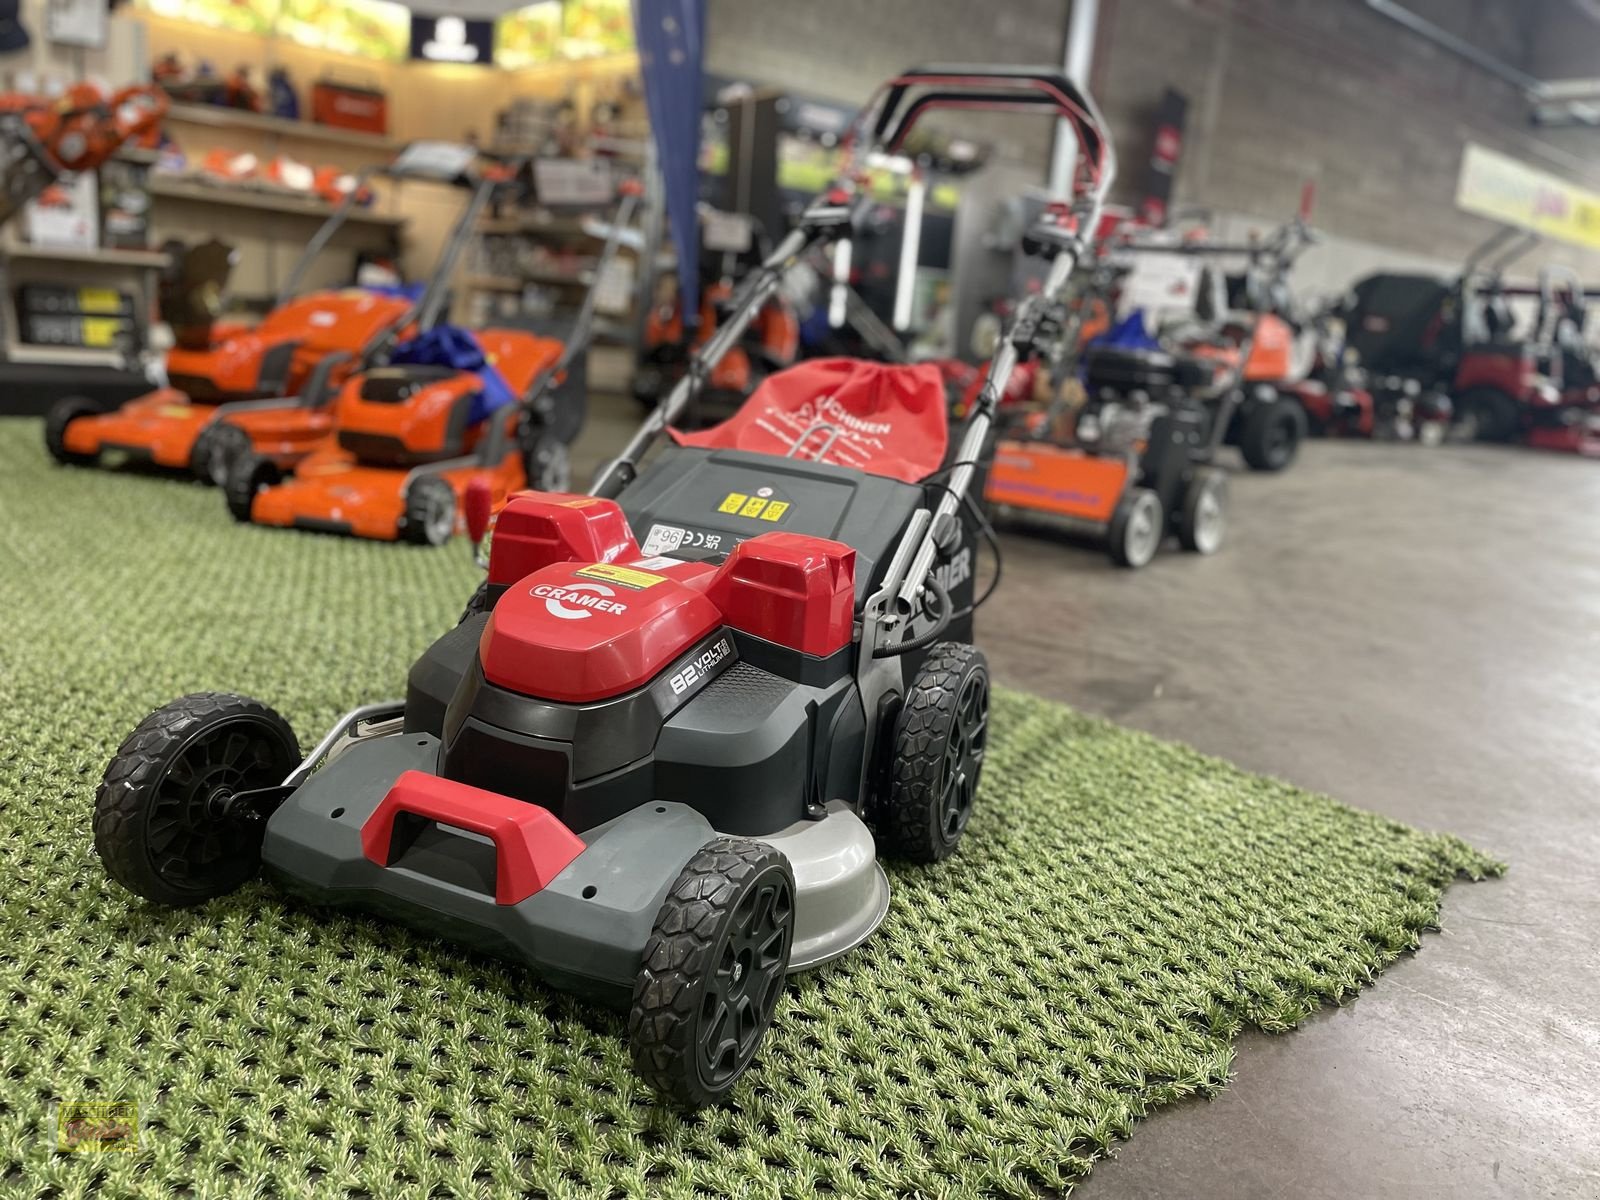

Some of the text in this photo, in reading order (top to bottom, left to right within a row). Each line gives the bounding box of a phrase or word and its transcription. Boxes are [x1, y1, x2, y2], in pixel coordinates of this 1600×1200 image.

[660, 529, 679, 544] 96
[534, 586, 628, 615] CRAMER
[669, 642, 721, 695] 82 VOLT
[697, 652, 724, 677] LITHIUM
